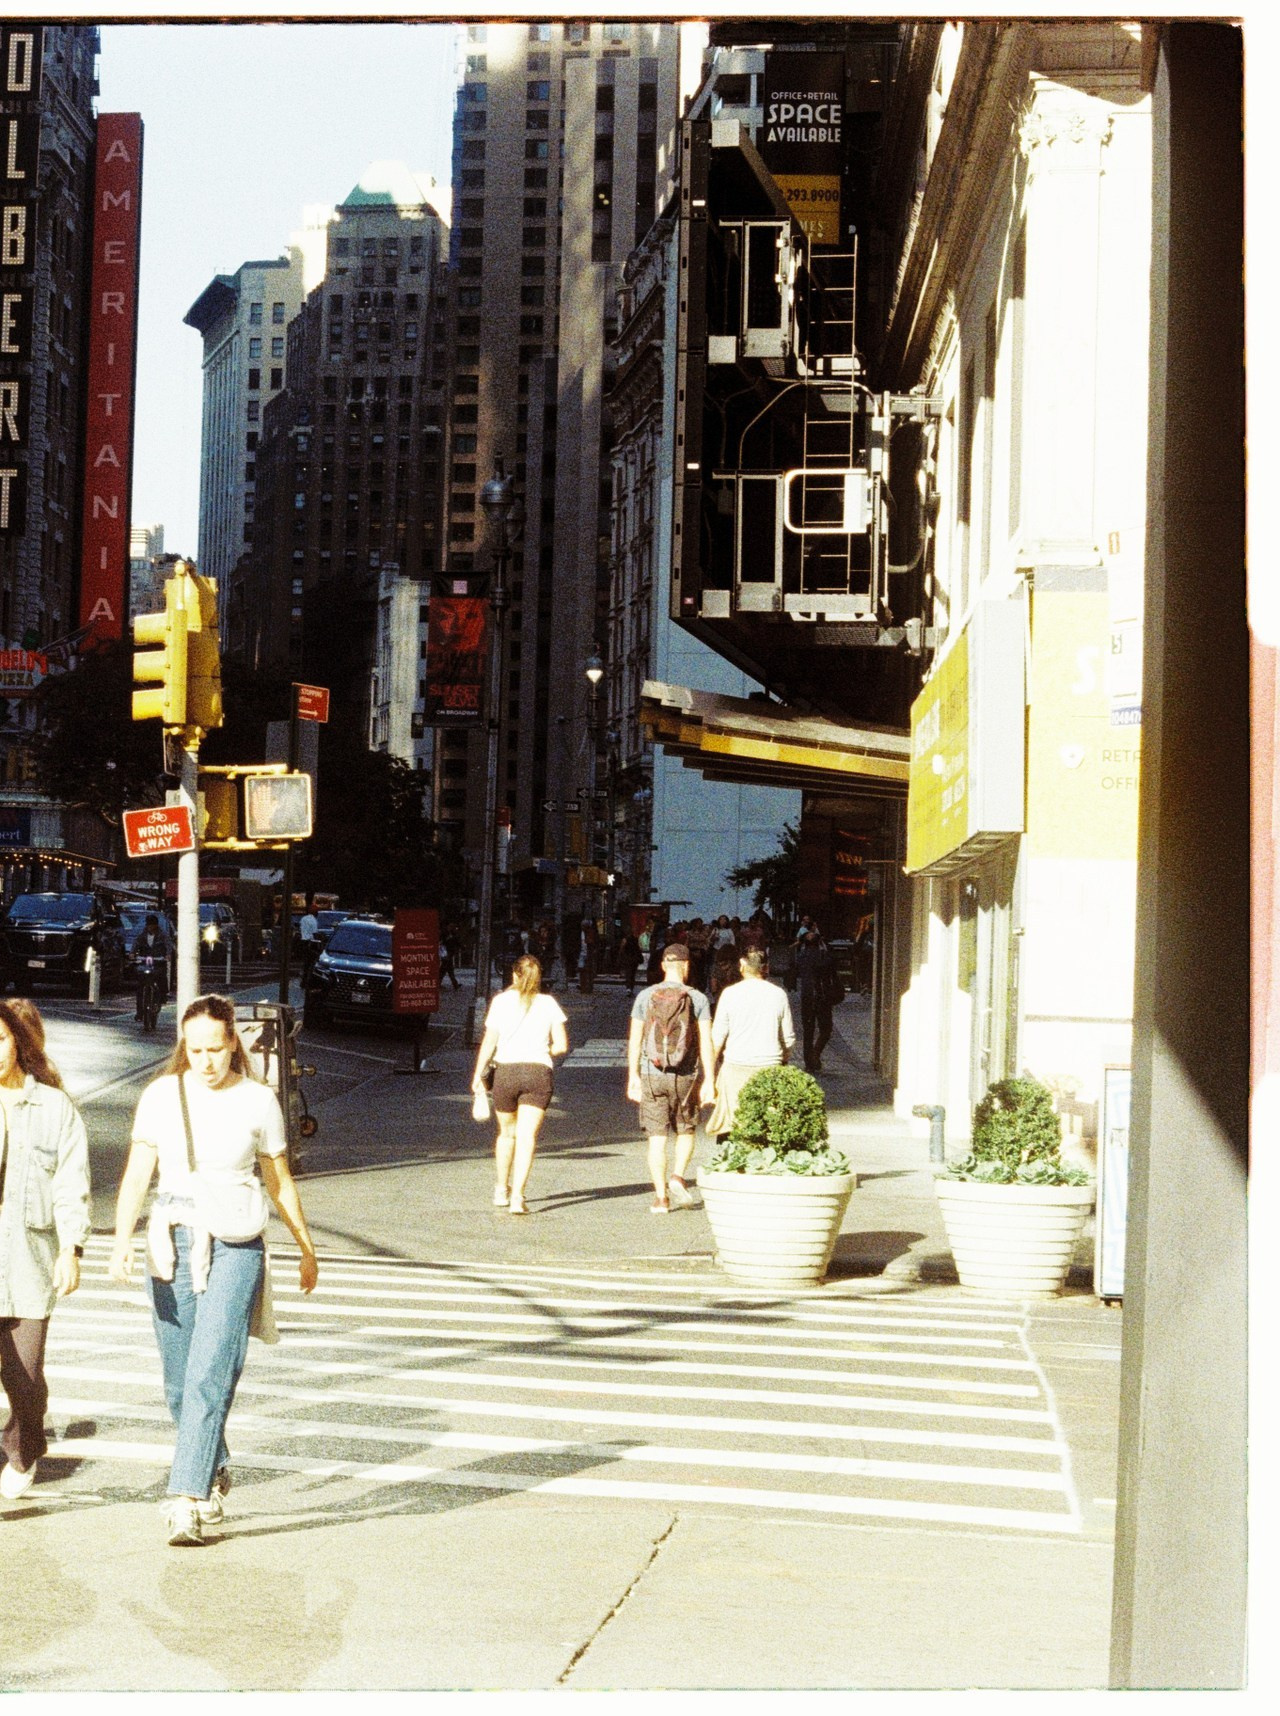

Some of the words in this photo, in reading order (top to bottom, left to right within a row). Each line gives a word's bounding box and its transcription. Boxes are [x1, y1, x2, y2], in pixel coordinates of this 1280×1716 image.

[767, 103, 842, 124] SPACE
[767, 127, 842, 143] AVAILABLE
[88, 139, 132, 622] AMERITANIA
[1102, 749, 1141, 762] RETA
[1101, 776, 1139, 790] OFFI
[137, 822, 181, 838] WRONG
[147, 836, 173, 849] WAY
[400, 953, 435, 962] MONTHLY
[406, 967, 430, 976] SPACE
[399, 979, 437, 989] AVAILABLE
